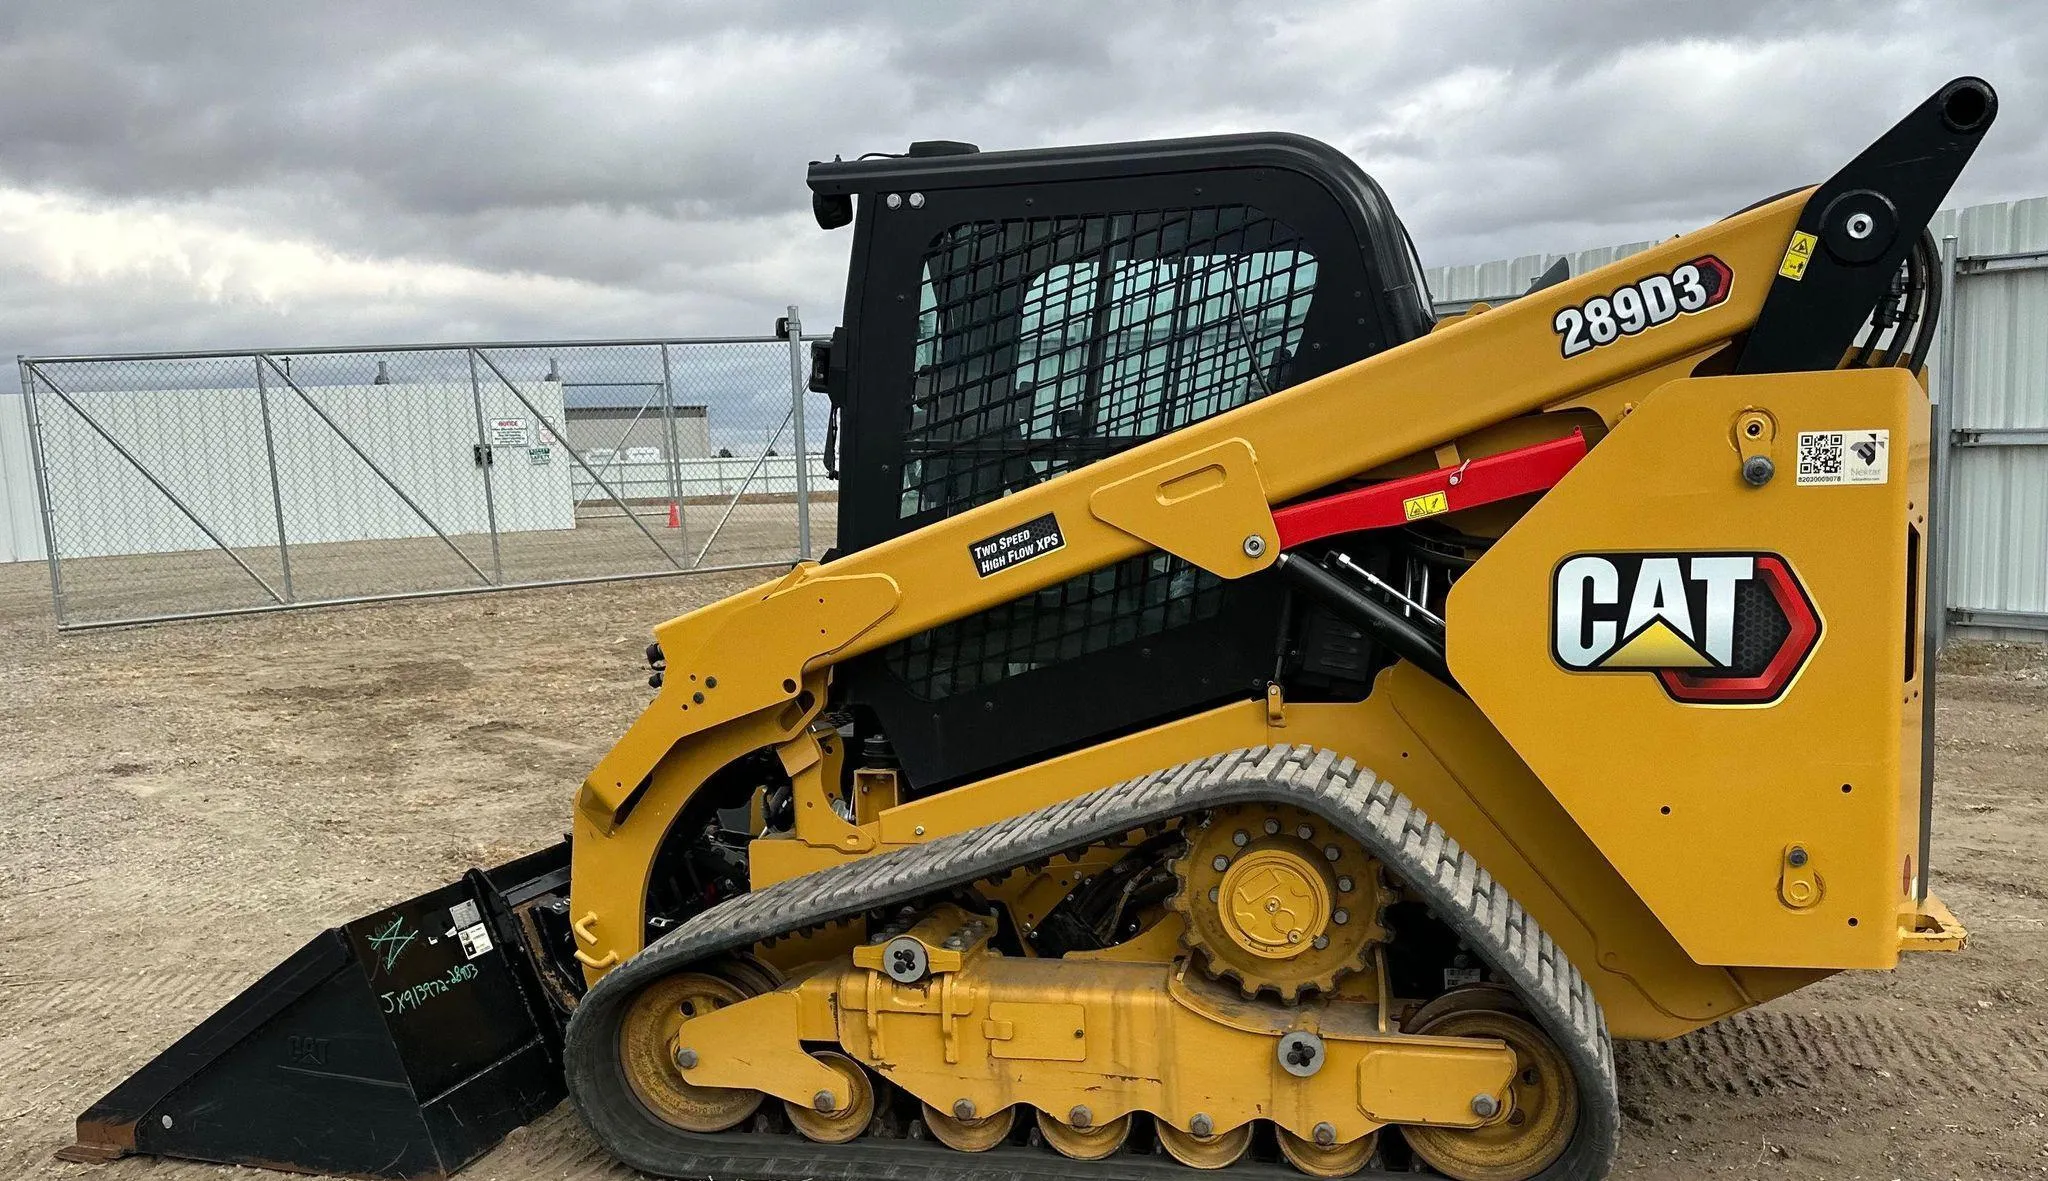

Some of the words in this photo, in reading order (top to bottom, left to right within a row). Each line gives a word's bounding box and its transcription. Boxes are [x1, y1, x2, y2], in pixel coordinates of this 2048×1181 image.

[1555, 264, 1707, 356] 289D3
[1036, 533, 1059, 552] XPS
[1556, 556, 1754, 667] CAT
[287, 1035, 330, 1065] CAT
